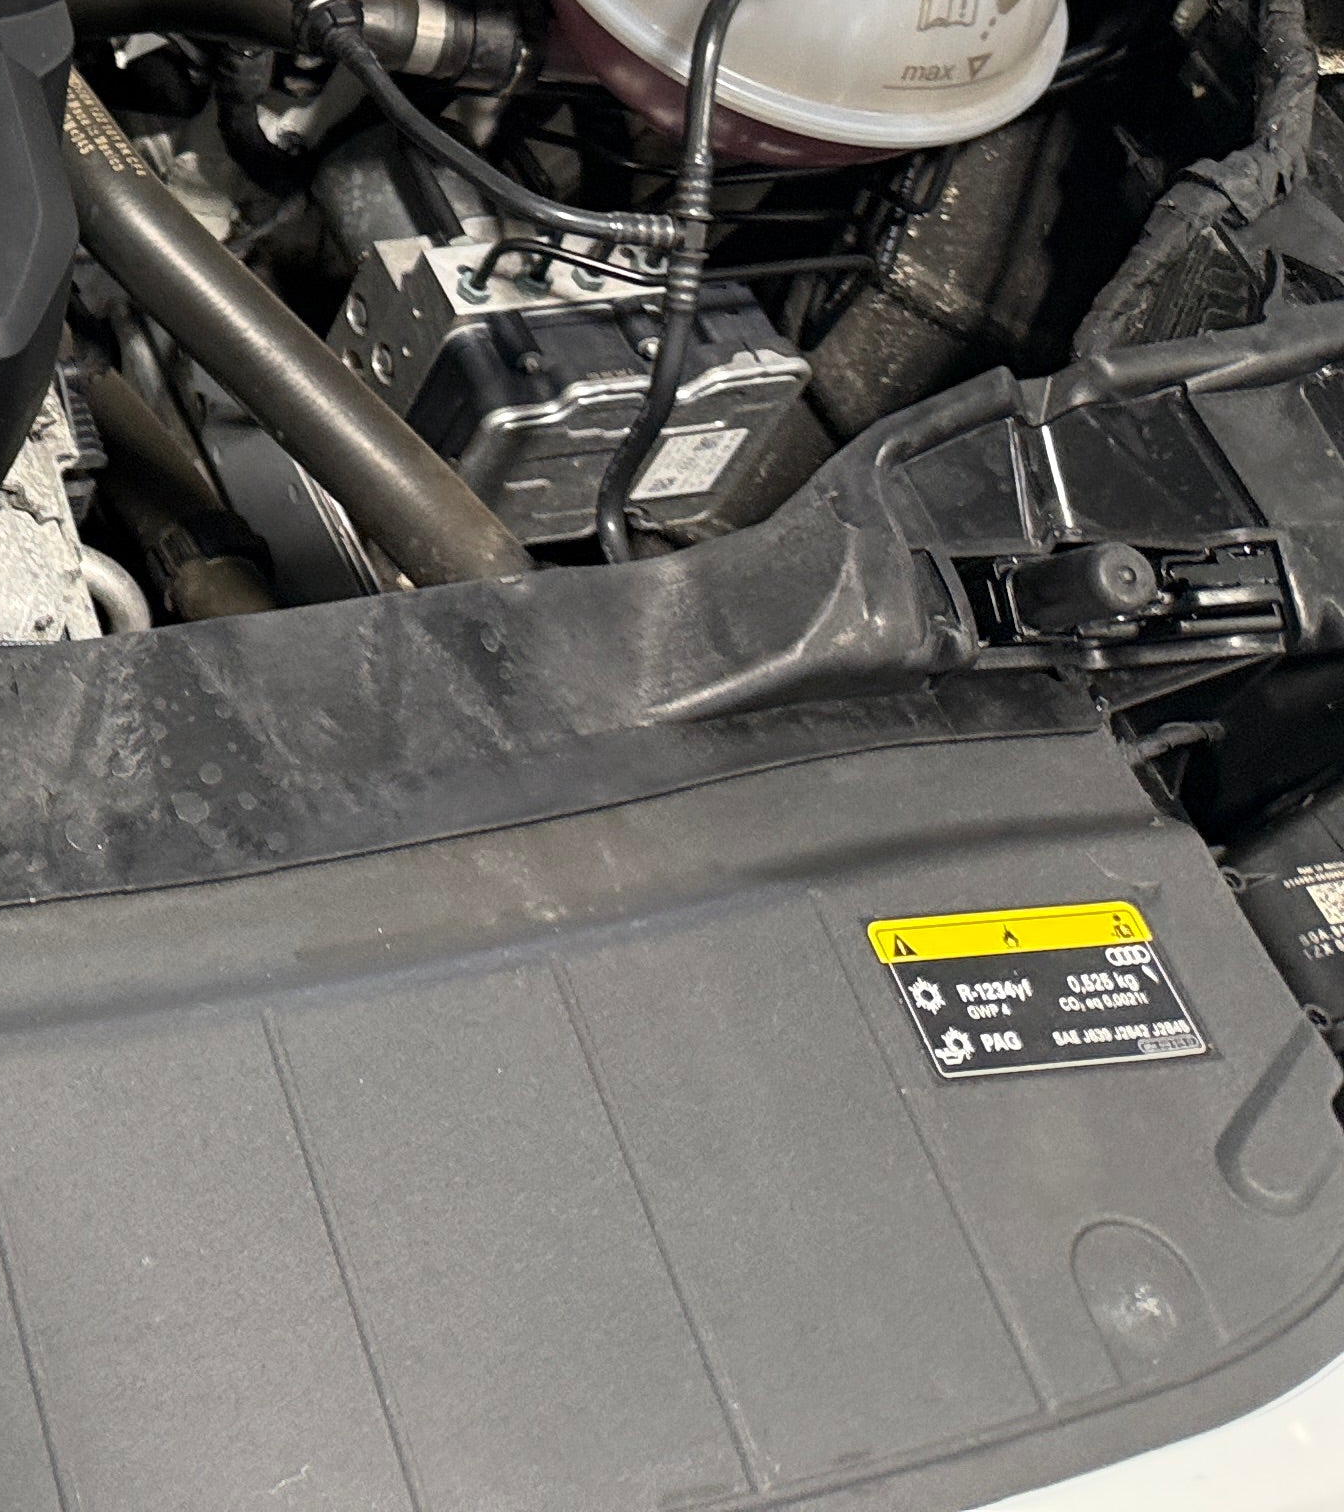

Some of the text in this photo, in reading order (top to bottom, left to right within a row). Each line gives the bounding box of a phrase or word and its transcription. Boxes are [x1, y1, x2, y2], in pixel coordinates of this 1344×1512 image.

[900, 61, 954, 82] max
[955, 978, 1033, 1003] R-1234yf
[1066, 971, 1140, 995] 0,525 kg
[966, 1002, 1012, 1020] GWP 4
[979, 1030, 1024, 1053] PAG
[1051, 1029, 1083, 1046] SAE
